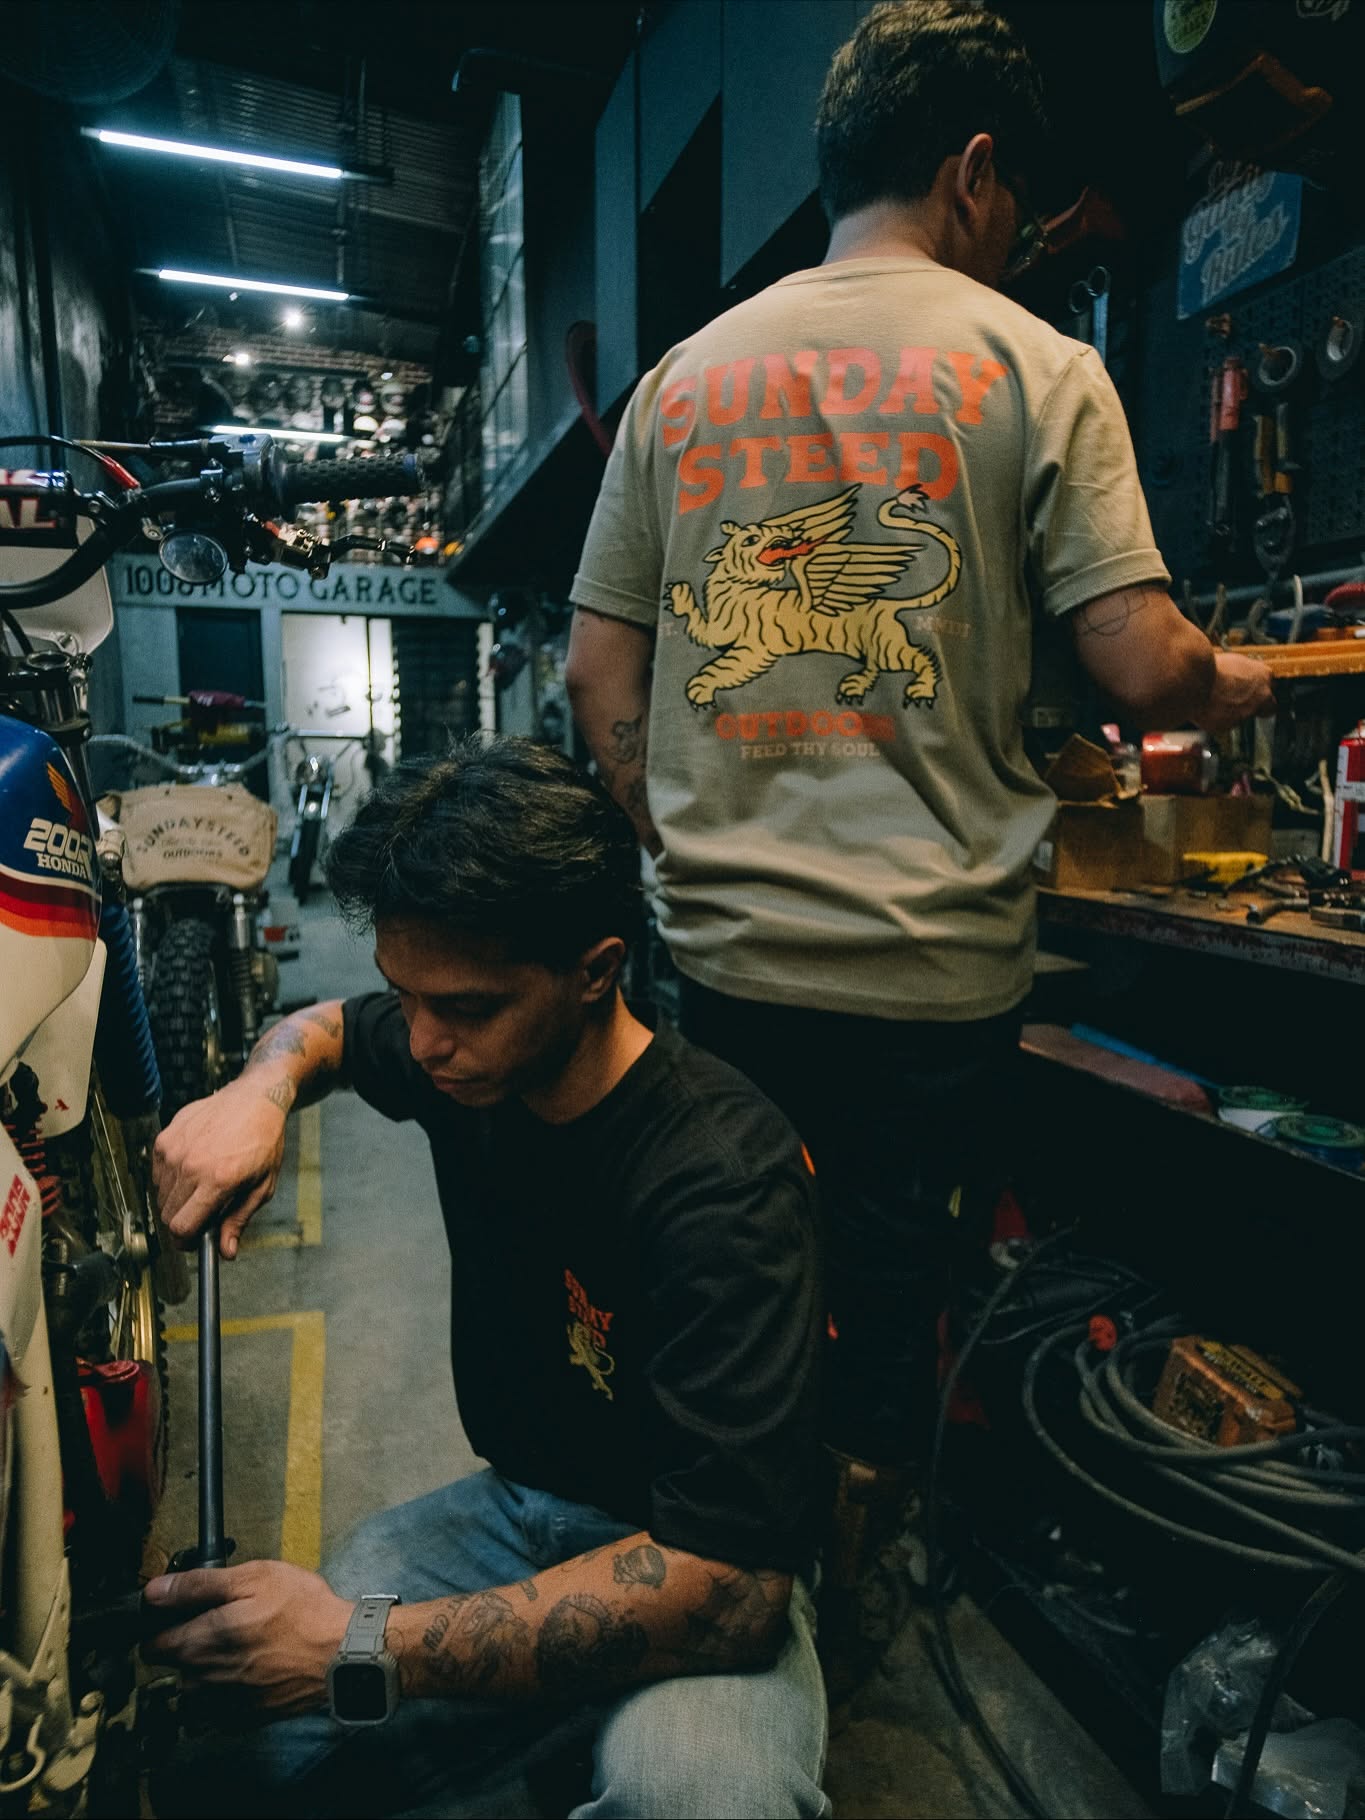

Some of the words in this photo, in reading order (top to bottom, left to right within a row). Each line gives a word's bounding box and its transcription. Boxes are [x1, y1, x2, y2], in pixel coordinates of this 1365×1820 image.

[660, 347, 1008, 446] SUNDAY
[678, 432, 960, 515] STEED
[310, 576, 437, 605] GARAGE
[36, 852, 89, 879] HONDA
